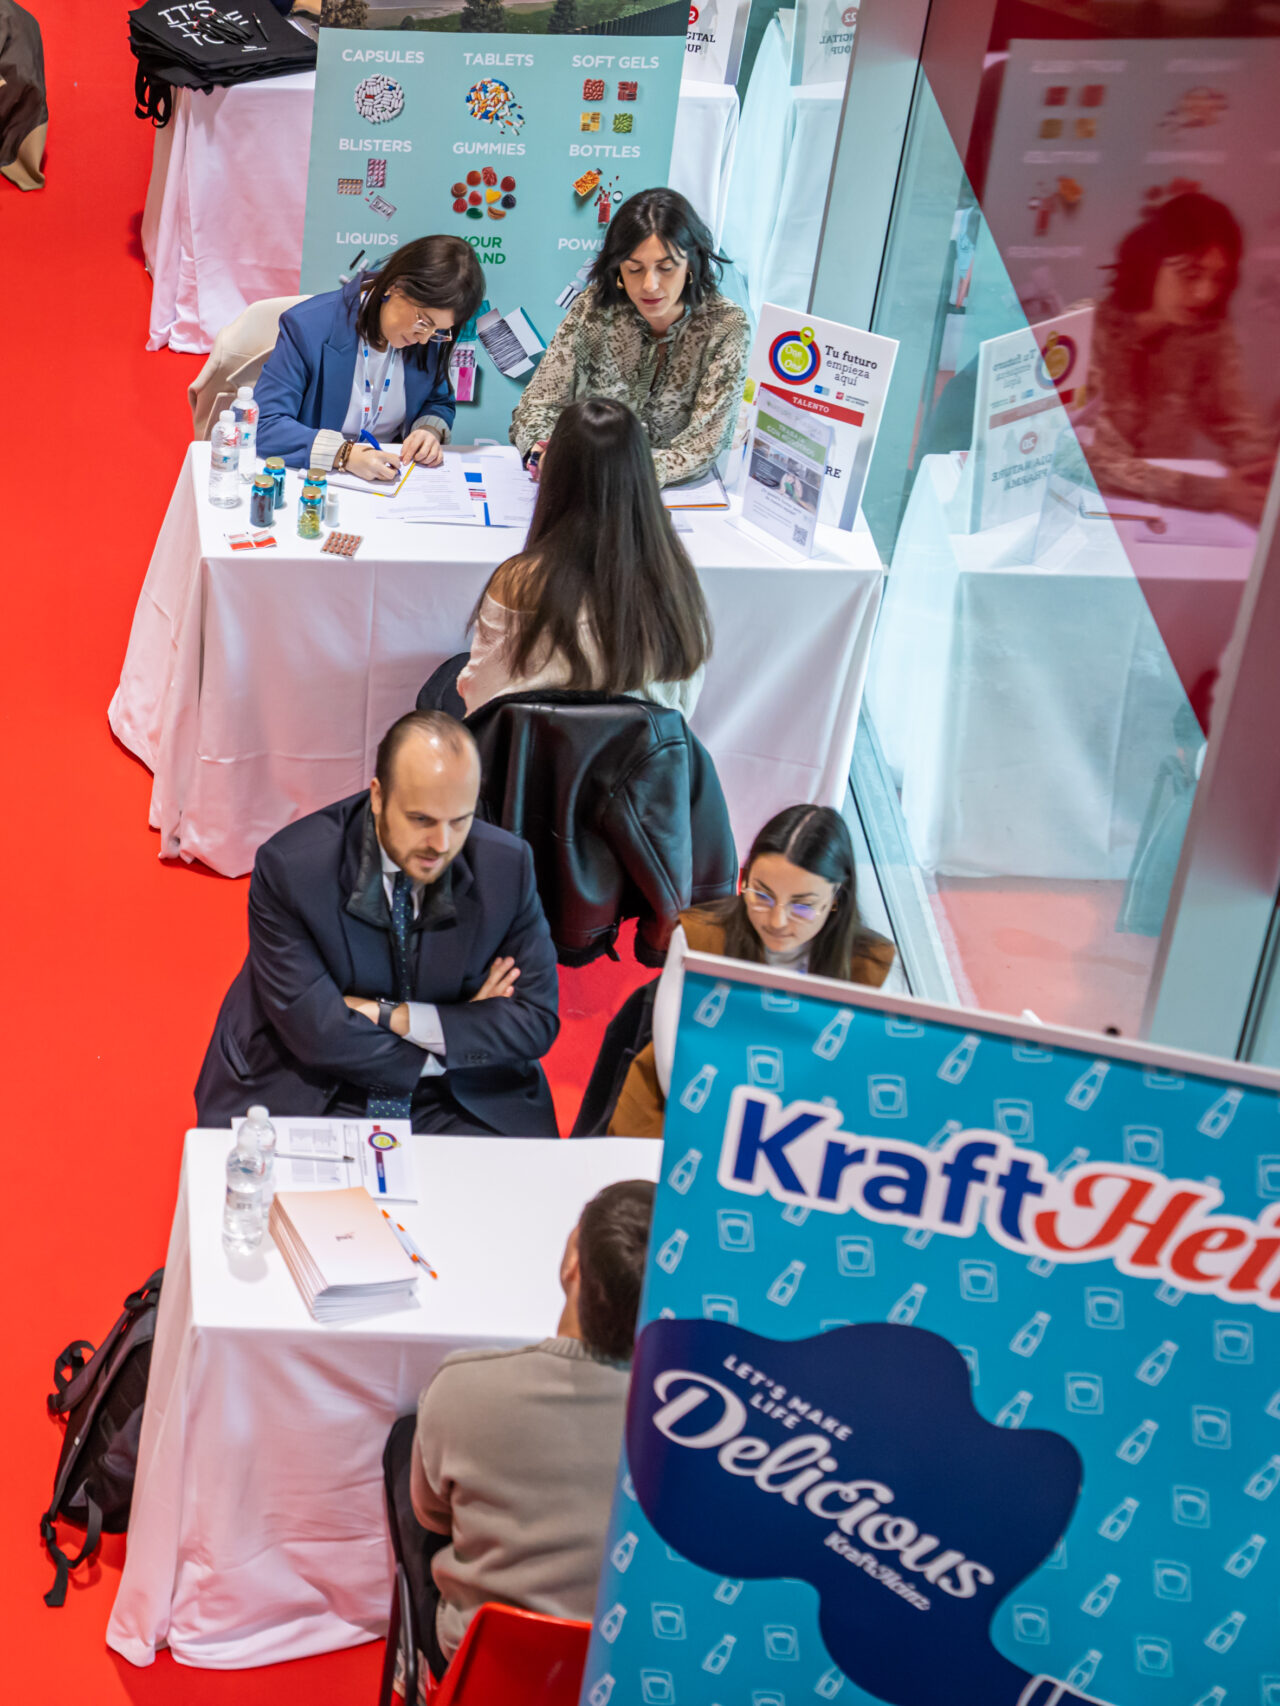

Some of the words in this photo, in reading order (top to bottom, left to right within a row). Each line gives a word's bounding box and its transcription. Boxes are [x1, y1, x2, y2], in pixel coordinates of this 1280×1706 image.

[688, 10, 696, 21] 2
[686, 31, 716, 43] GITAL
[342, 48, 425, 64] CAPSULES
[463, 52, 535, 67] TABLETS
[572, 55, 615, 69] SOFT
[618, 56, 660, 69] GELS
[338, 138, 412, 153] BLISTERS
[452, 142, 526, 156] GUMMIES
[569, 144, 641, 158] BOTTLES
[336, 232, 399, 246] LIQUIDS
[464, 236, 503, 248] OUR
[825, 345, 839, 358] Tu
[842, 351, 878, 370] futuro
[826, 360, 870, 379] empieza
[834, 373, 857, 386] aquí
[792, 396, 830, 413] TALENTO
[733, 1098, 1280, 1300] KraftHei
[723, 1354, 787, 1402] LET'S
[787, 1395, 853, 1442] MAKE
[749, 1392, 801, 1430] LIFE
[653, 1369, 995, 1599] Delicious
[824, 1531, 931, 1611] KraftHeinz
